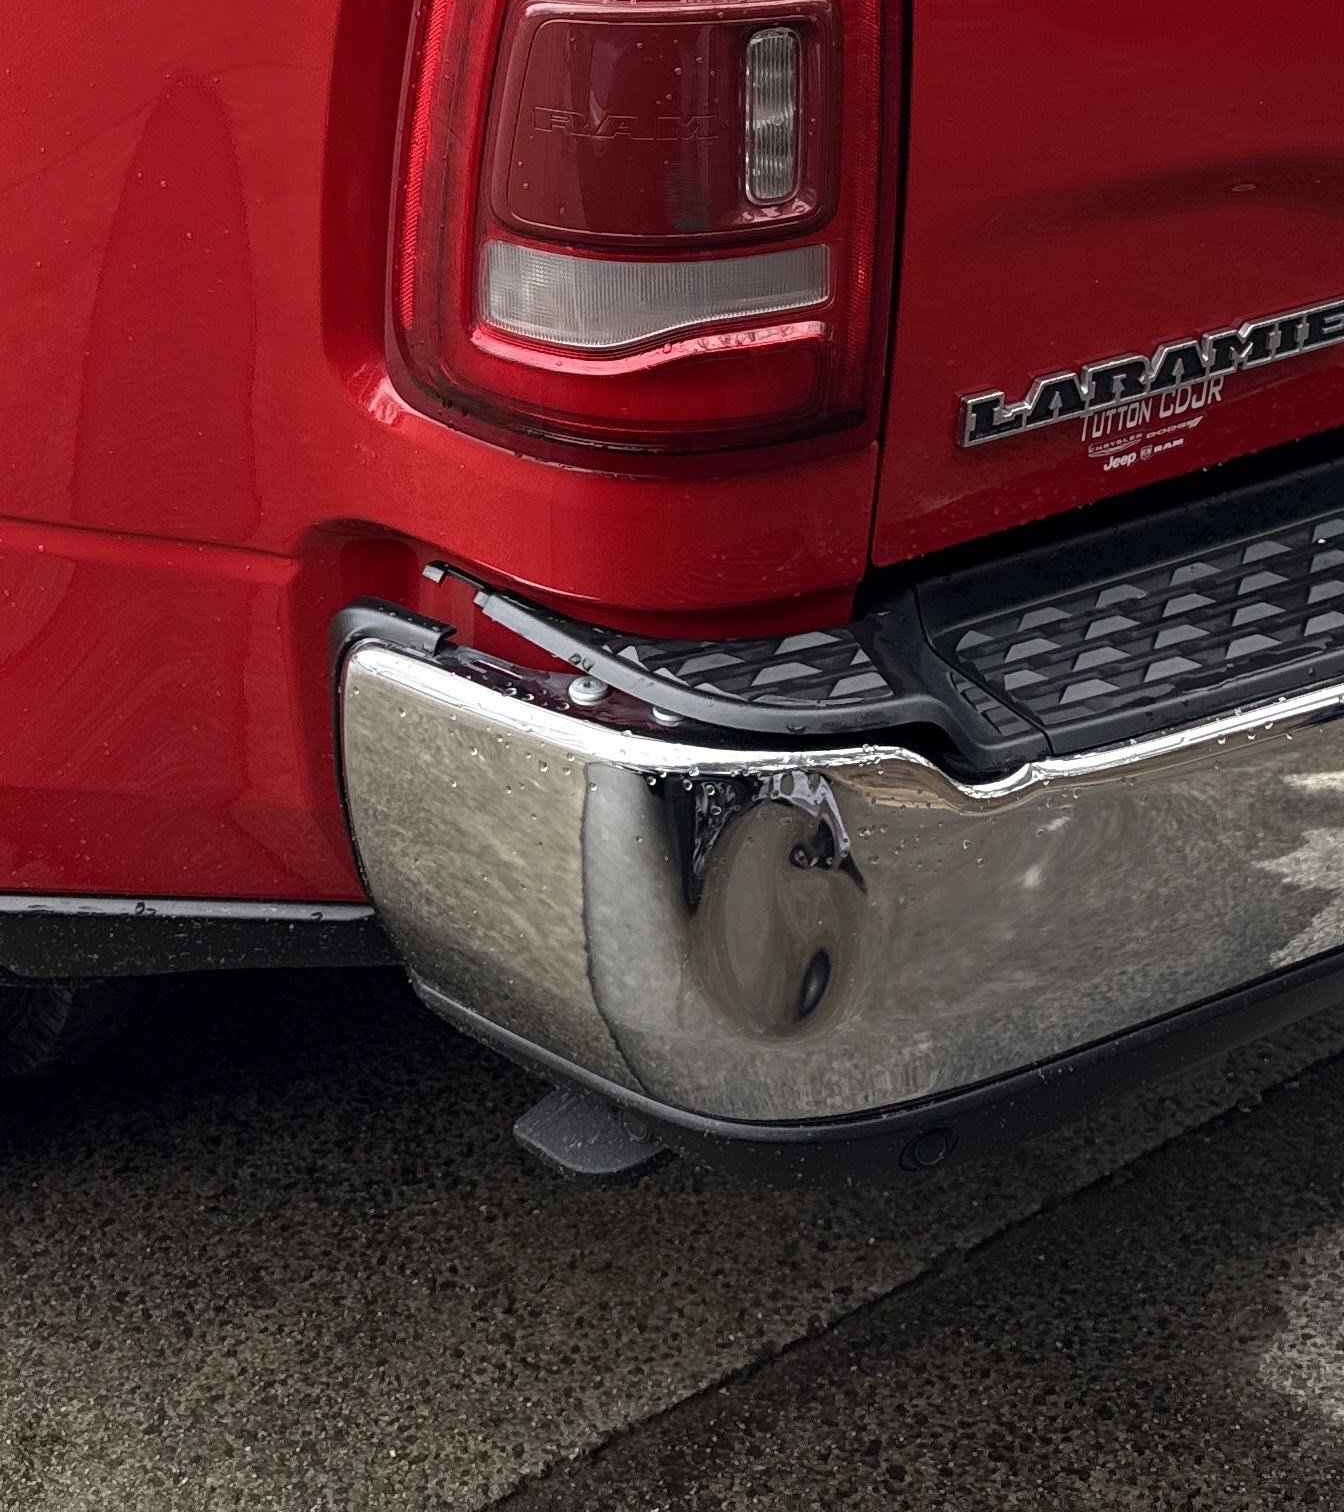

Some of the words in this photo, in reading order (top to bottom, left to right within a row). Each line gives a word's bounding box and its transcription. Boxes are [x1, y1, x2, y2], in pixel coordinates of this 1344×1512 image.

[533, 106, 719, 140] RAM
[1080, 397, 1153, 442] TUTTON
[1159, 376, 1225, 419] CDJR
[1088, 432, 1144, 455] CHRYSLER
[1103, 451, 1138, 471] Jeep
[1154, 438, 1185, 453] RAM
